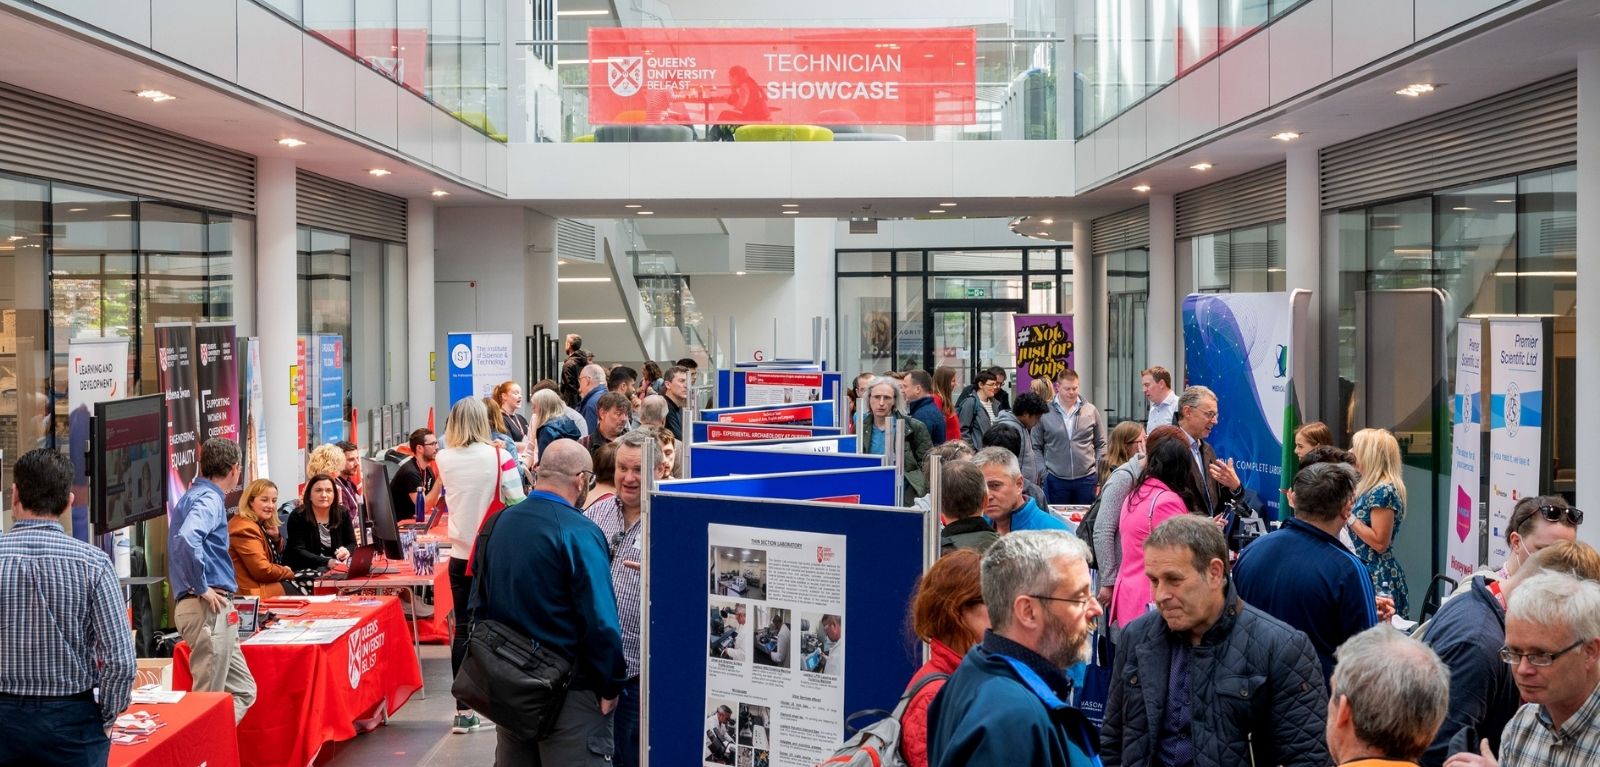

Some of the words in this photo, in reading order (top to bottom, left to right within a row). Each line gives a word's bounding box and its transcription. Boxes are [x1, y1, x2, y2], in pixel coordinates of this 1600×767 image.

[647, 57, 697, 68] QUEEN'S
[763, 53, 901, 73] TECHNICIAN
[647, 69, 717, 80] UNIVERSITY
[647, 80, 691, 90] BELFAST
[766, 81, 899, 100] SHOWCASE
[1515, 334, 1539, 349] Premier
[454, 351, 469, 362] IST
[753, 350, 763, 362] G
[1017, 342, 1046, 366] just
[1046, 339, 1073, 362] for
[1500, 350, 1526, 366] Scientific
[1526, 353, 1538, 366] Ltd
[79, 365, 102, 376] LEARNING
[102, 363, 113, 373] AND
[1029, 357, 1066, 380] boys
[80, 379, 112, 391] DEVELOPMENT
[206, 397, 231, 409] SUPPORTING
[207, 412, 222, 422] WOMEN
[222, 411, 227, 420] IN
[223, 424, 236, 434] SINCE
[723, 430, 751, 438] EXPERIMENTAL
[171, 448, 196, 470] EQUALITY
[1235, 460, 1269, 473] COMPLETE
[777, 541, 803, 549] LABORATORY
